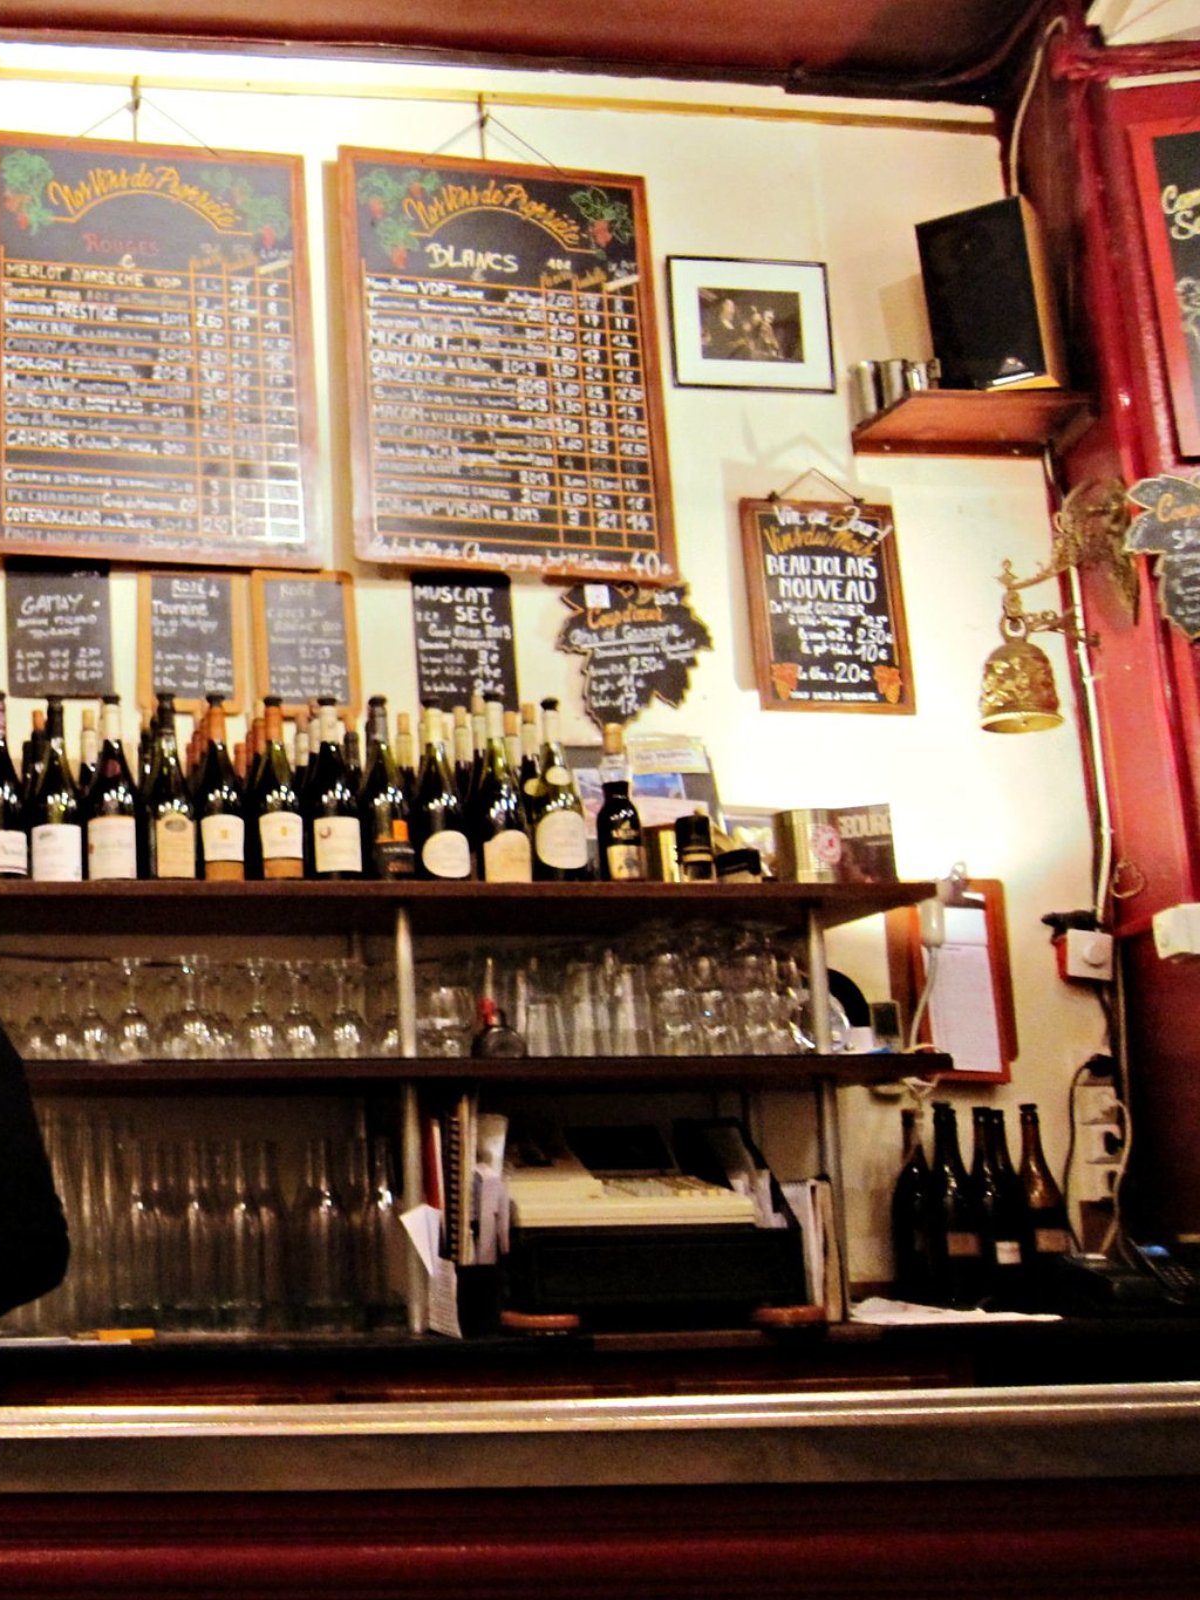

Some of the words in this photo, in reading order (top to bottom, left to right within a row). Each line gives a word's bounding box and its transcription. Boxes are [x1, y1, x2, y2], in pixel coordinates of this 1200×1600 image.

[425, 243, 519, 274] BLANCS
[765, 553, 878, 580] BEAUJOLAIS
[414, 585, 494, 606] MUSCAT
[779, 577, 876, 604] NOUVEAU
